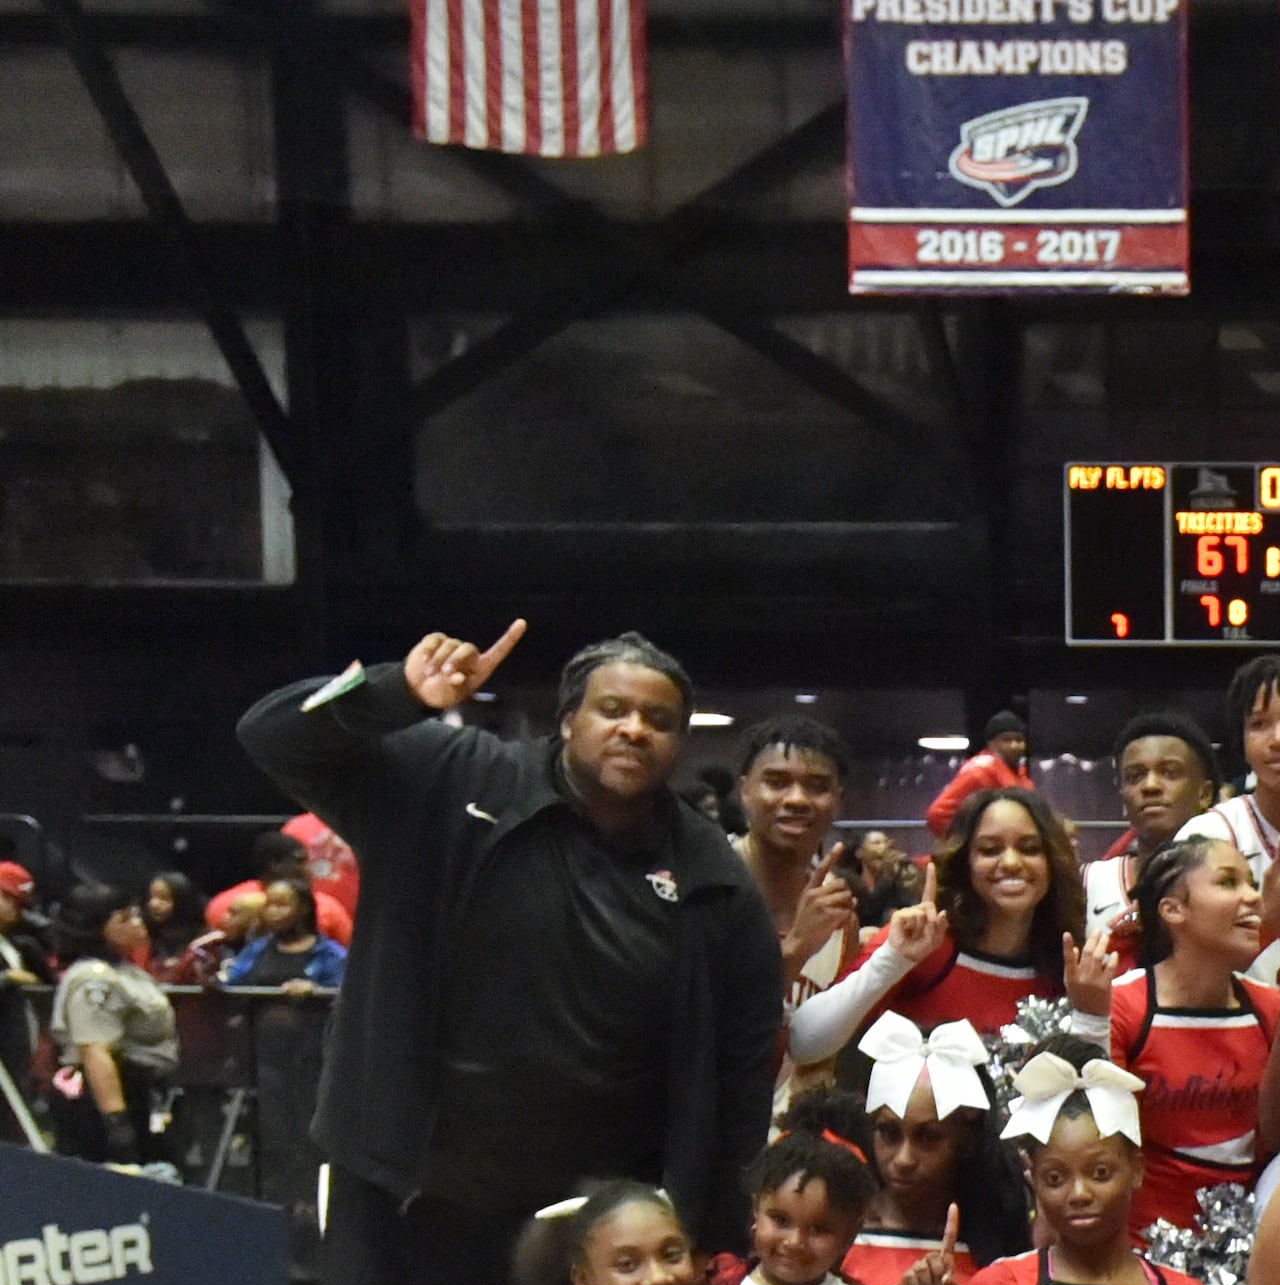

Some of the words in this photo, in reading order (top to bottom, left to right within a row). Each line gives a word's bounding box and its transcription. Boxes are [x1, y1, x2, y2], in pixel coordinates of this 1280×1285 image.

[1101, 0, 1179, 23] CUP
[905, 40, 1127, 75] CHAMPIONS
[916, 229, 1004, 263] 2016
[1036, 229, 1121, 263] 2017
[1197, 535, 1250, 577] 67
[1200, 595, 1222, 628] 7
